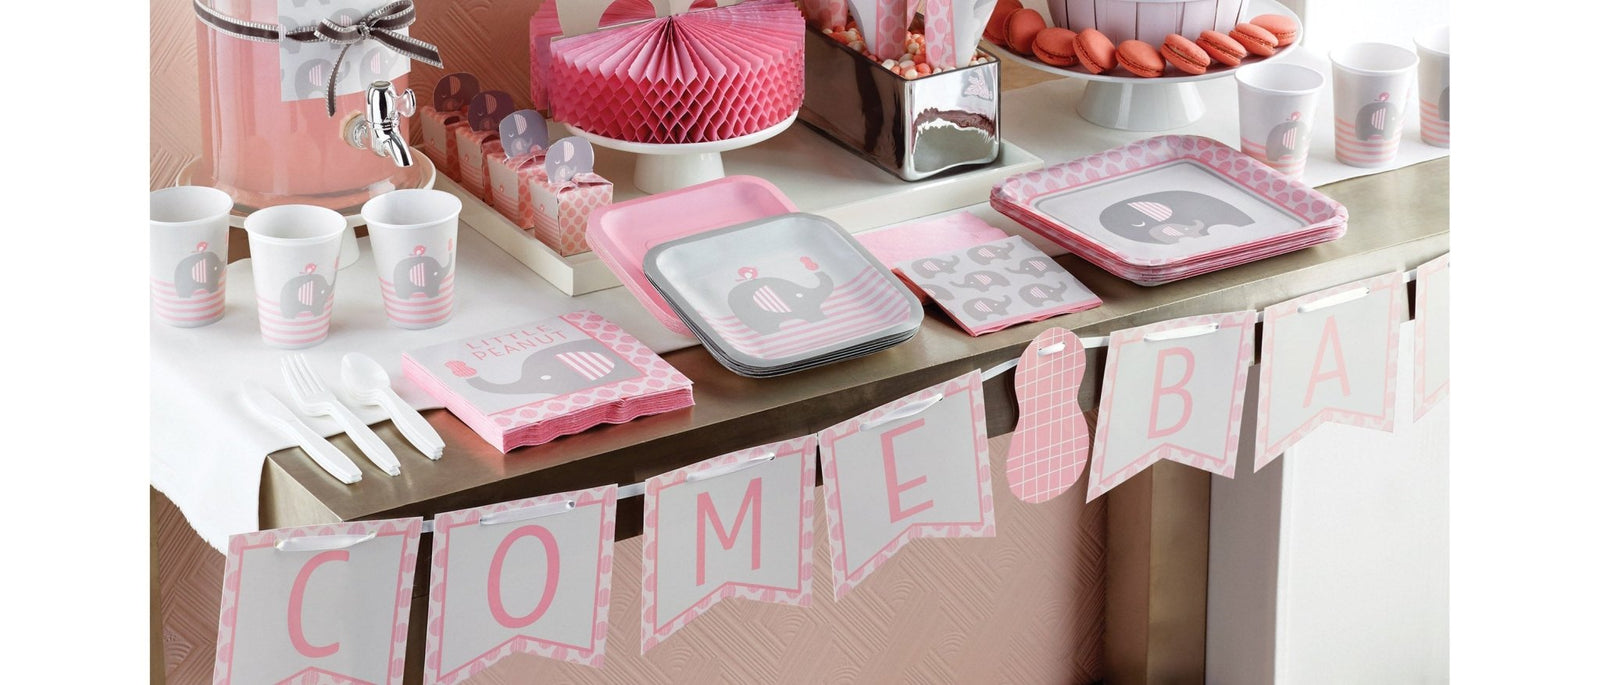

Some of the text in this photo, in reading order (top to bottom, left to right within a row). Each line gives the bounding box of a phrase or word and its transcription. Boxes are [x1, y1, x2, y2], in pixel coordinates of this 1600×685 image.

[466, 324, 553, 350] LITTLE
[472, 330, 567, 361] PEANUT
[287, 418, 934, 659] COME
